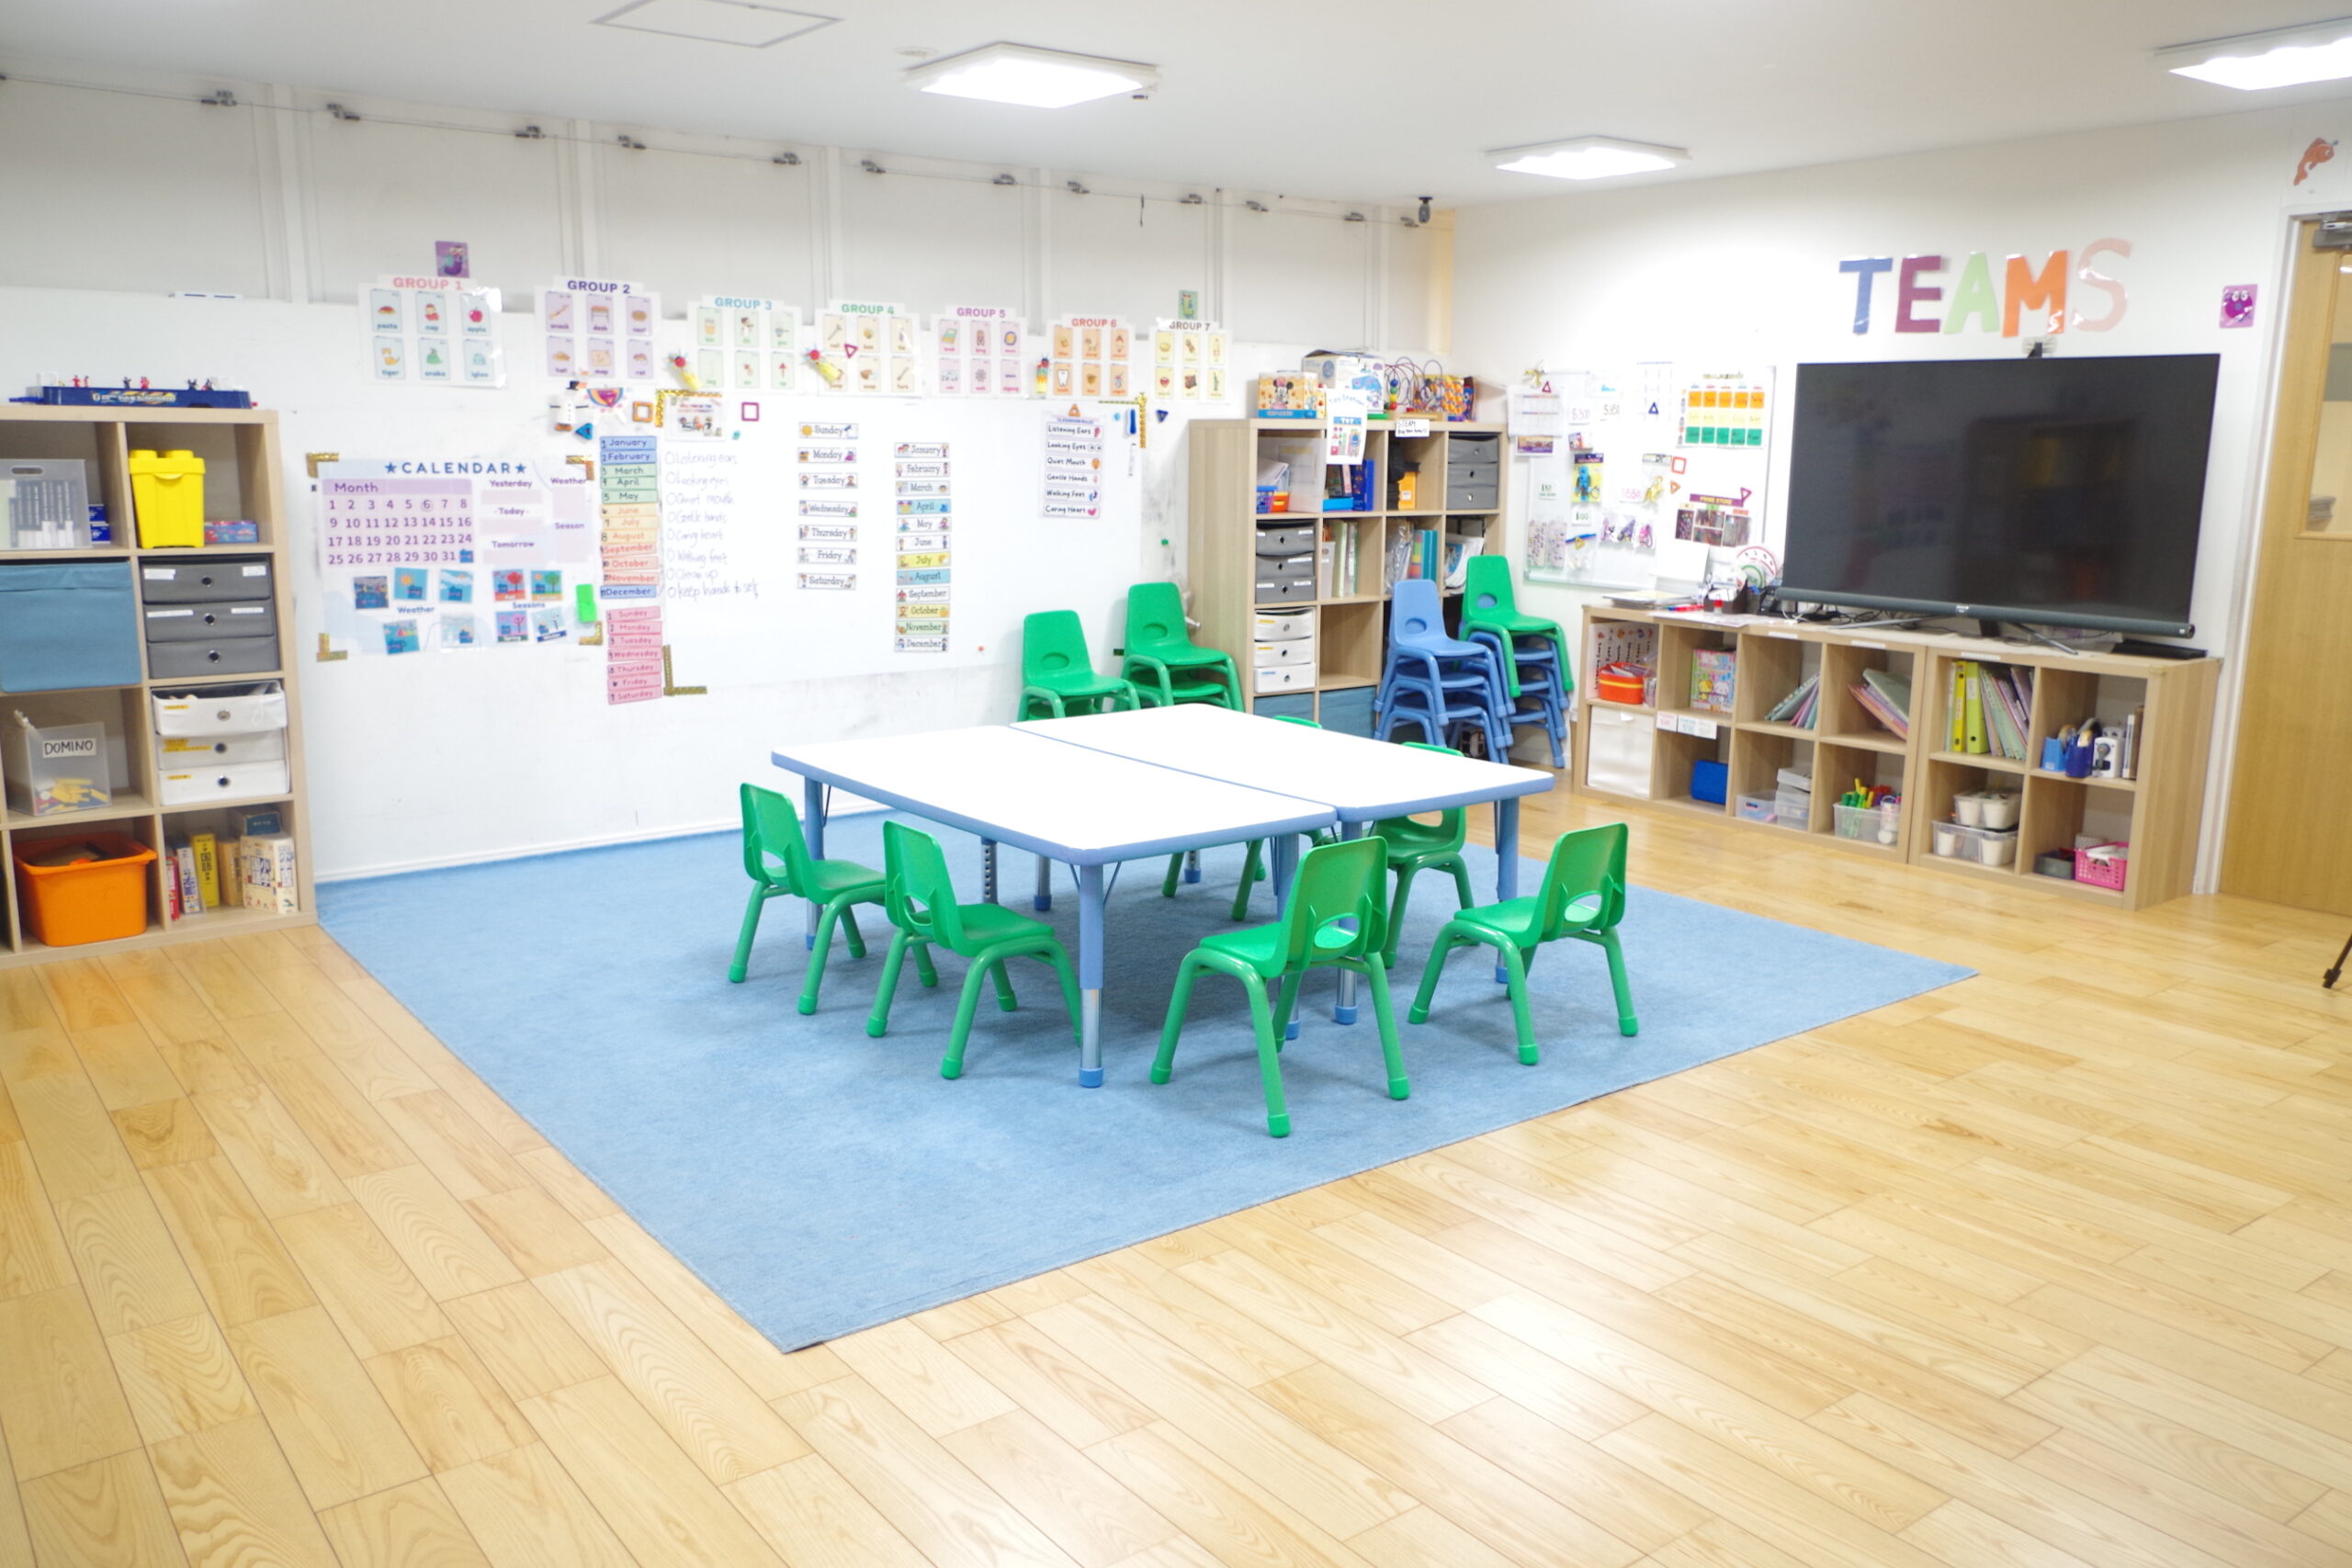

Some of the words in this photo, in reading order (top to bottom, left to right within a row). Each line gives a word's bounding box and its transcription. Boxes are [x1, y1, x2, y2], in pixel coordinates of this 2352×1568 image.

[393, 277, 449, 290] GROUP
[456, 281, 463, 290] 1
[567, 279, 617, 292] GROUP
[623, 284, 630, 294] 2
[1838, 237, 2133, 338] TEAMS
[715, 296, 761, 309] GROUP
[764, 301, 772, 310] 3
[841, 303, 884, 314] GROUP
[887, 306, 895, 315] 4
[956, 307, 996, 318] GROUP
[999, 309, 1006, 318] 5
[1071, 318, 1108, 327] GROUP
[1169, 321, 1203, 331] GROUP
[814, 424, 843, 437] Sunday
[1047, 426, 1075, 435] Listening
[1077, 427, 1091, 435] Ears
[609, 439, 647, 447] January
[1047, 442, 1070, 451] Looking
[1071, 443, 1086, 452] Eyes
[813, 449, 843, 461] Monday
[911, 445, 941, 456] January
[608, 452, 650, 461] February
[401, 462, 511, 474] CALENDAR
[615, 467, 643, 475] March
[907, 463, 941, 474] February
[490, 479, 533, 489] Yesterday
[617, 478, 639, 487] April
[812, 475, 845, 487] Tuesday
[334, 482, 379, 492] Month
[910, 483, 933, 492] March
[619, 492, 639, 502] May
[1046, 490, 1070, 498] Walking
[330, 500, 335, 510] 1
[348, 500, 355, 510] 2
[368, 500, 375, 510] 3
[387, 500, 393, 509] 4
[405, 500, 413, 509] 5
[424, 500, 430, 509] 6
[441, 500, 447, 509] 7
[460, 499, 467, 508] 8
[808, 503, 849, 514] Wednesday
[915, 502, 934, 513] April
[1046, 505, 1066, 514] Caring
[498, 507, 525, 516] Today
[331, 518, 337, 527] 9
[346, 518, 360, 528] 10
[366, 518, 379, 528] 11
[385, 518, 398, 527] 12
[404, 517, 417, 526] 13
[423, 517, 435, 527] 14
[440, 517, 453, 526] 15
[458, 517, 471, 526] 16
[621, 518, 639, 527] July
[917, 520, 933, 529] May
[613, 533, 645, 542] August
[812, 527, 847, 539] Thursday
[329, 537, 342, 547] 17
[347, 536, 362, 546] 18
[367, 536, 380, 546] 19
[386, 536, 400, 545] 20
[405, 536, 418, 545] 21
[423, 536, 436, 545] 22
[441, 535, 455, 544] 23
[458, 534, 471, 543] 24
[492, 540, 535, 548] Tomorrow
[915, 537, 932, 546] June
[604, 543, 652, 553] September
[329, 555, 344, 564] 25
[348, 554, 363, 564] 26
[368, 553, 381, 563] 27
[386, 553, 401, 562] 28
[405, 552, 419, 561] 29
[424, 552, 437, 561] 30
[442, 552, 456, 561] 31
[818, 549, 842, 562] Friday
[915, 555, 932, 566] July
[612, 559, 649, 568] October
[608, 574, 655, 582] November
[808, 575, 845, 588] Saturday
[915, 571, 941, 582] August
[606, 588, 650, 596] December
[909, 589, 946, 600] September
[397, 605, 435, 615] Weather
[911, 606, 939, 615] October
[906, 623, 941, 631] November
[620, 637, 652, 645] Tuesday
[907, 638, 941, 648] December
[617, 691, 652, 700] Saturday
[44, 740, 93, 755] DOMINO
